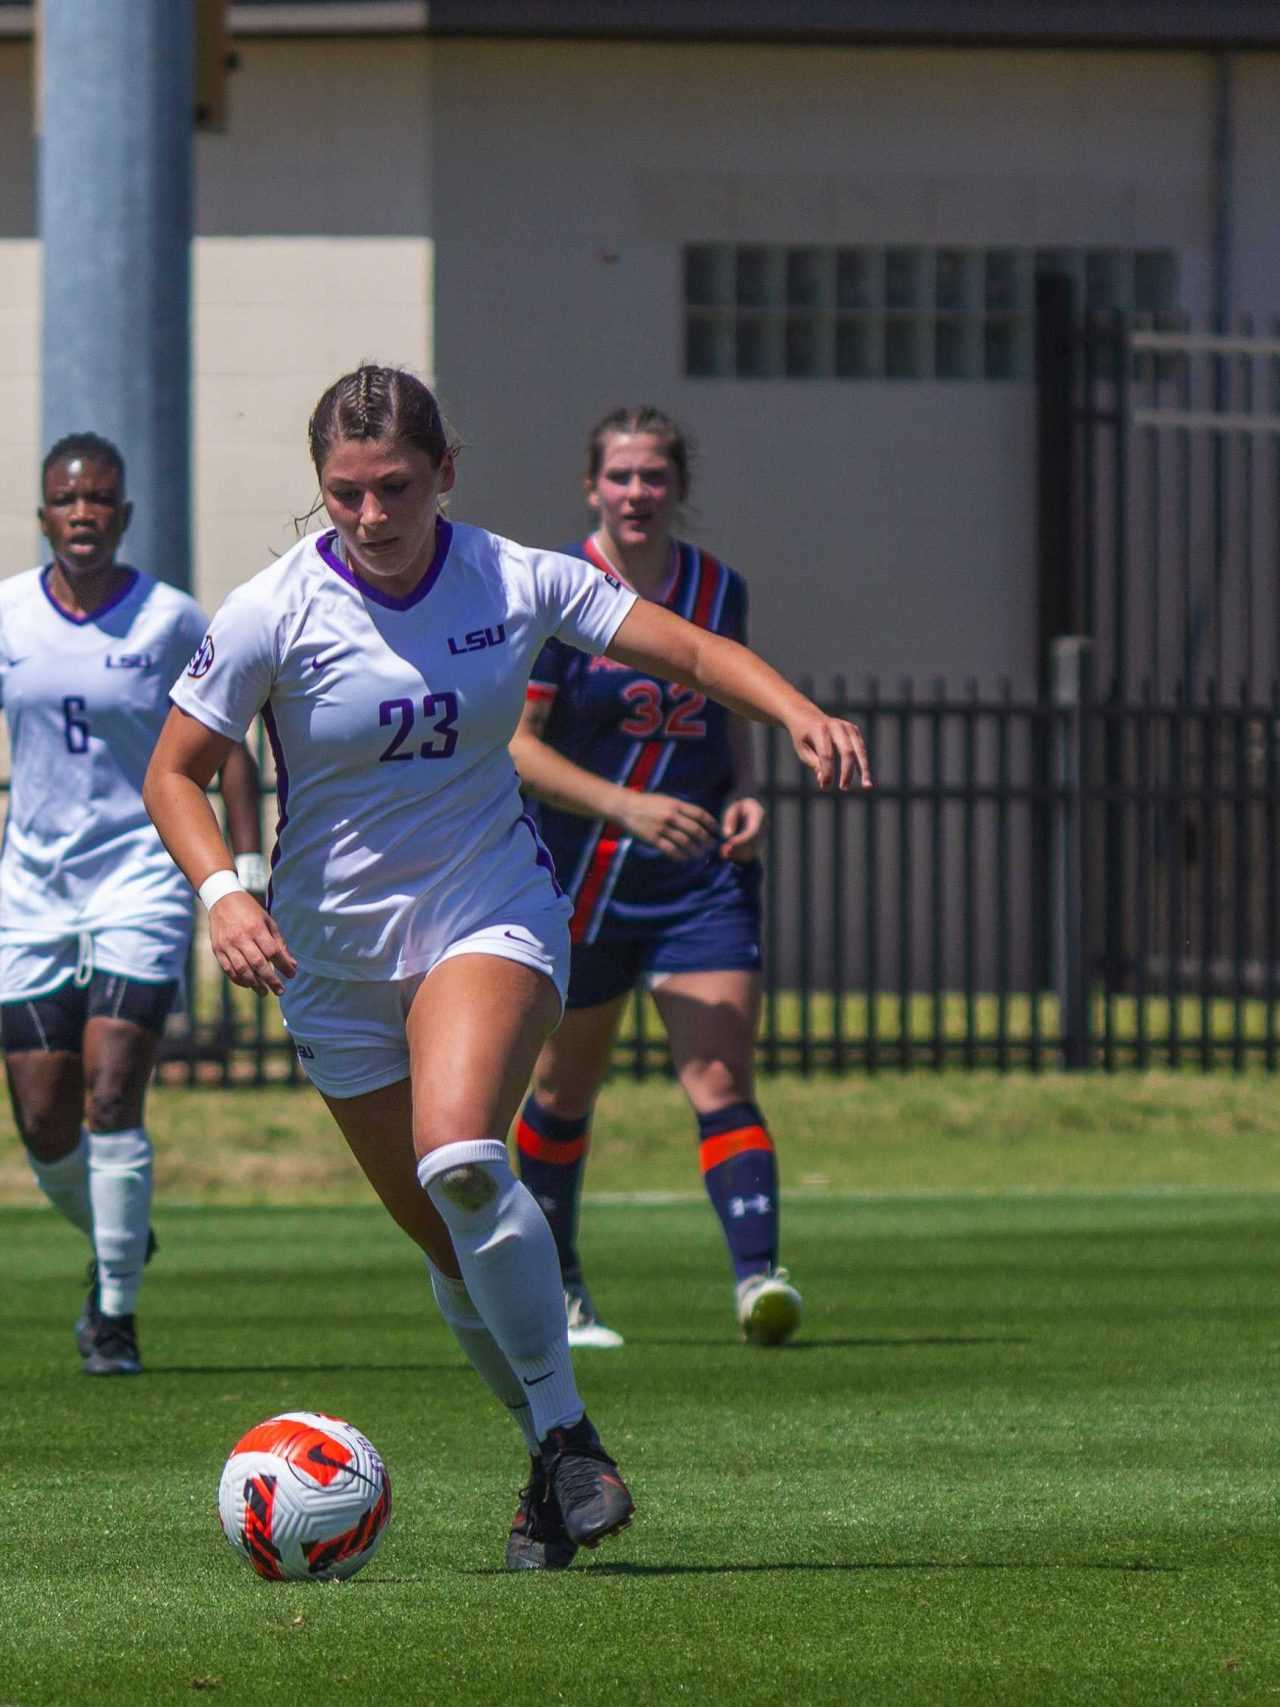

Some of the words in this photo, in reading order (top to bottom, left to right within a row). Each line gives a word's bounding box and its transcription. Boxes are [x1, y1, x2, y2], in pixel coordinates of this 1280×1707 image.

[105, 653, 152, 670] LSU
[448, 624, 506, 656] LSU
[62, 696, 89, 755] 6
[378, 691, 459, 763] 23
[622, 679, 706, 737] 32
